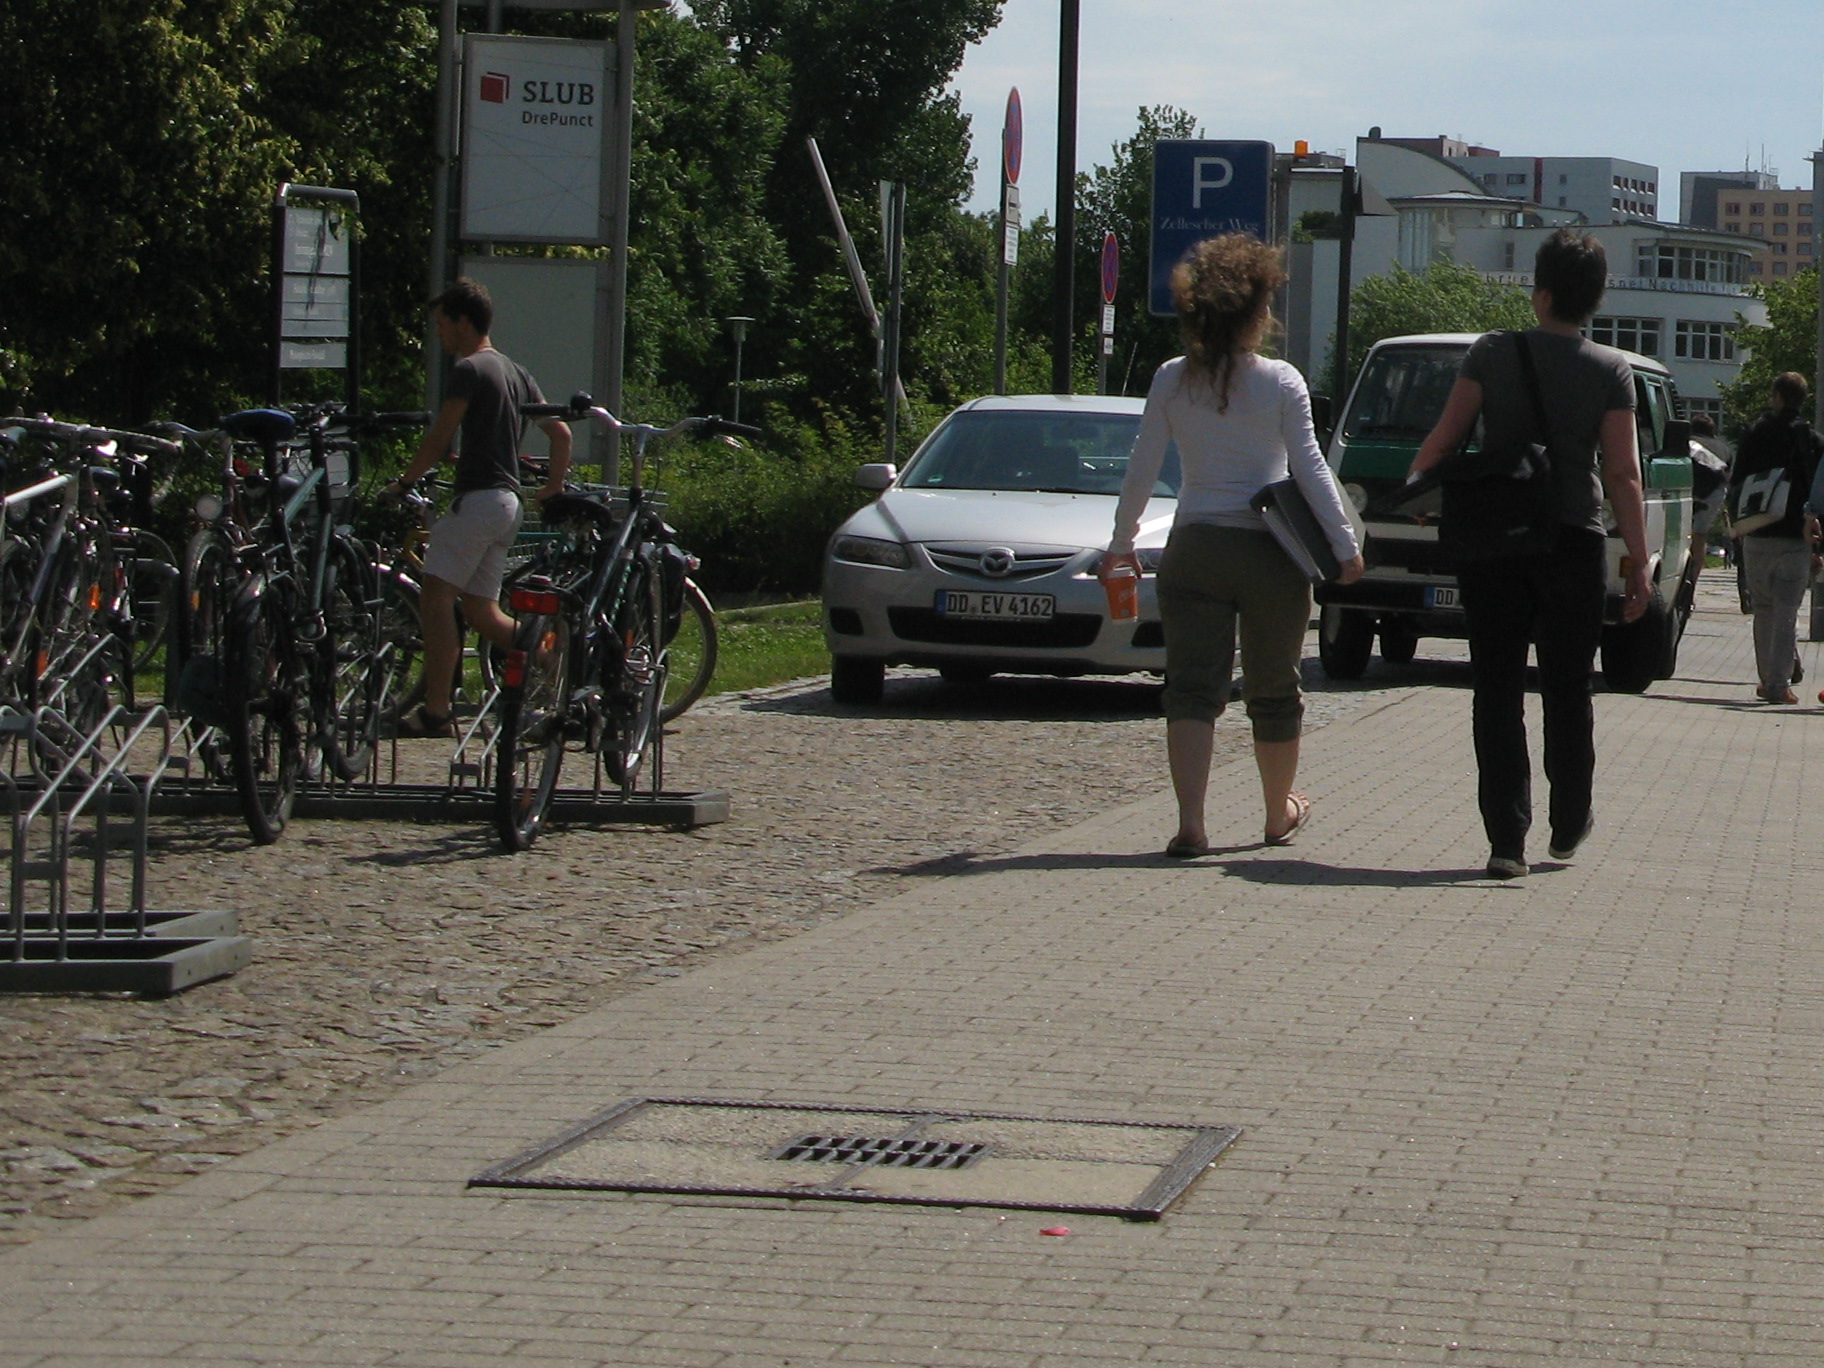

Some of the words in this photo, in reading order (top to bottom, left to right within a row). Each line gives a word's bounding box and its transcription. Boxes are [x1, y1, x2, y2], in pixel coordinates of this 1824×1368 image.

[522, 81, 594, 105] SLUB
[522, 111, 593, 127] DrePunct
[1192, 157, 1234, 209] P
[1160, 217, 1223, 230] Zellescher
[1228, 218, 1260, 232] Weg
[947, 594, 969, 613] DD
[981, 595, 1004, 614] EV
[1008, 597, 1052, 616] 4162
[1436, 589, 1454, 605] DD
